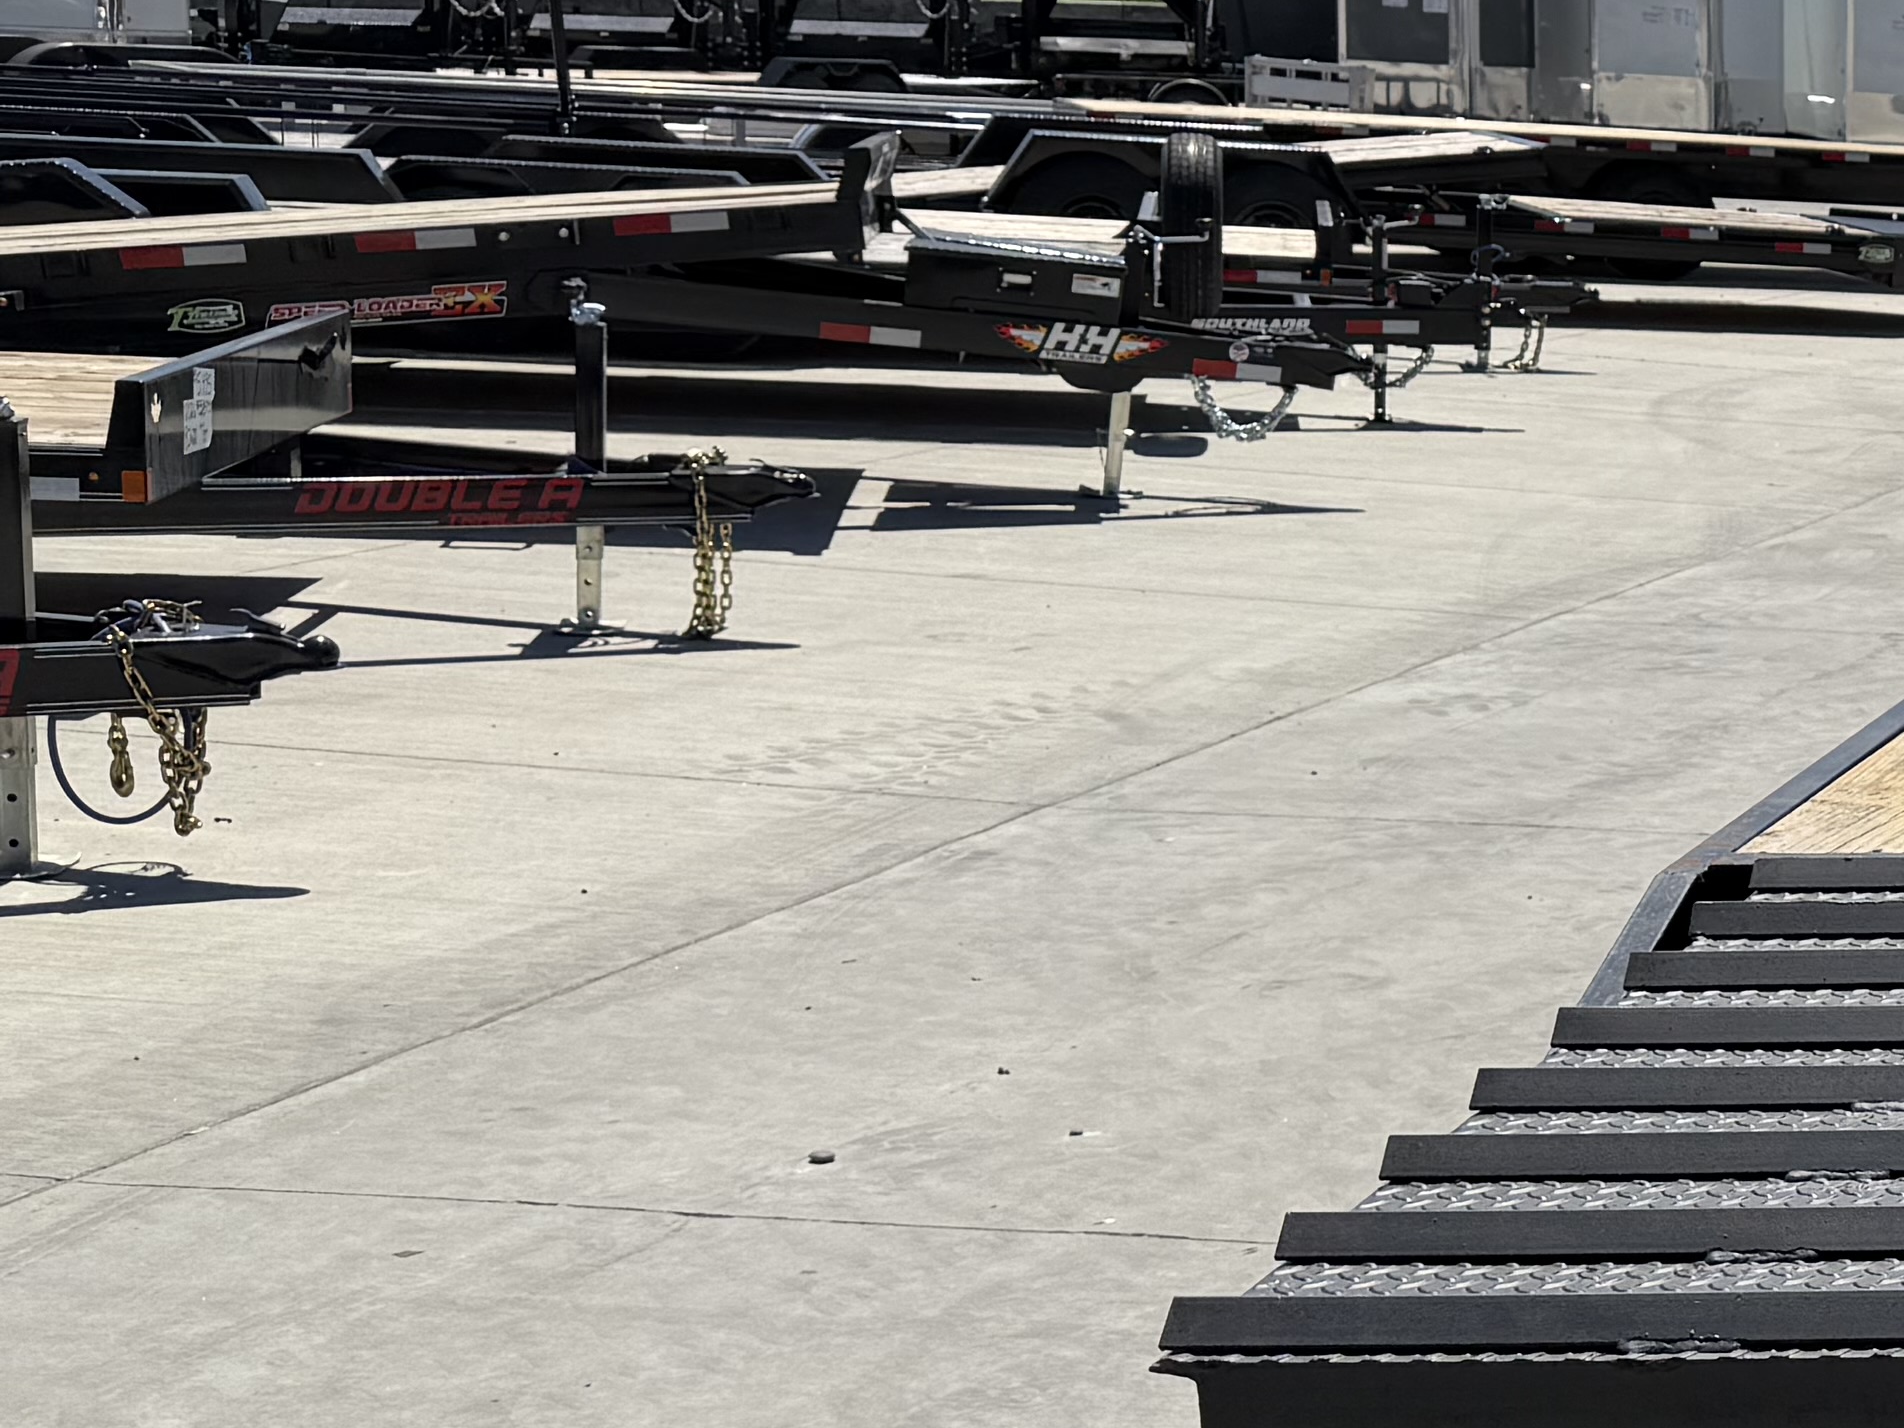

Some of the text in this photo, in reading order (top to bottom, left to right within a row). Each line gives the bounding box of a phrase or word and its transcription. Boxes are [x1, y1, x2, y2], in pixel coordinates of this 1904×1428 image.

[1190, 317, 1311, 332] SOUTHLAND
[294, 478, 585, 514] DOUBLE A
